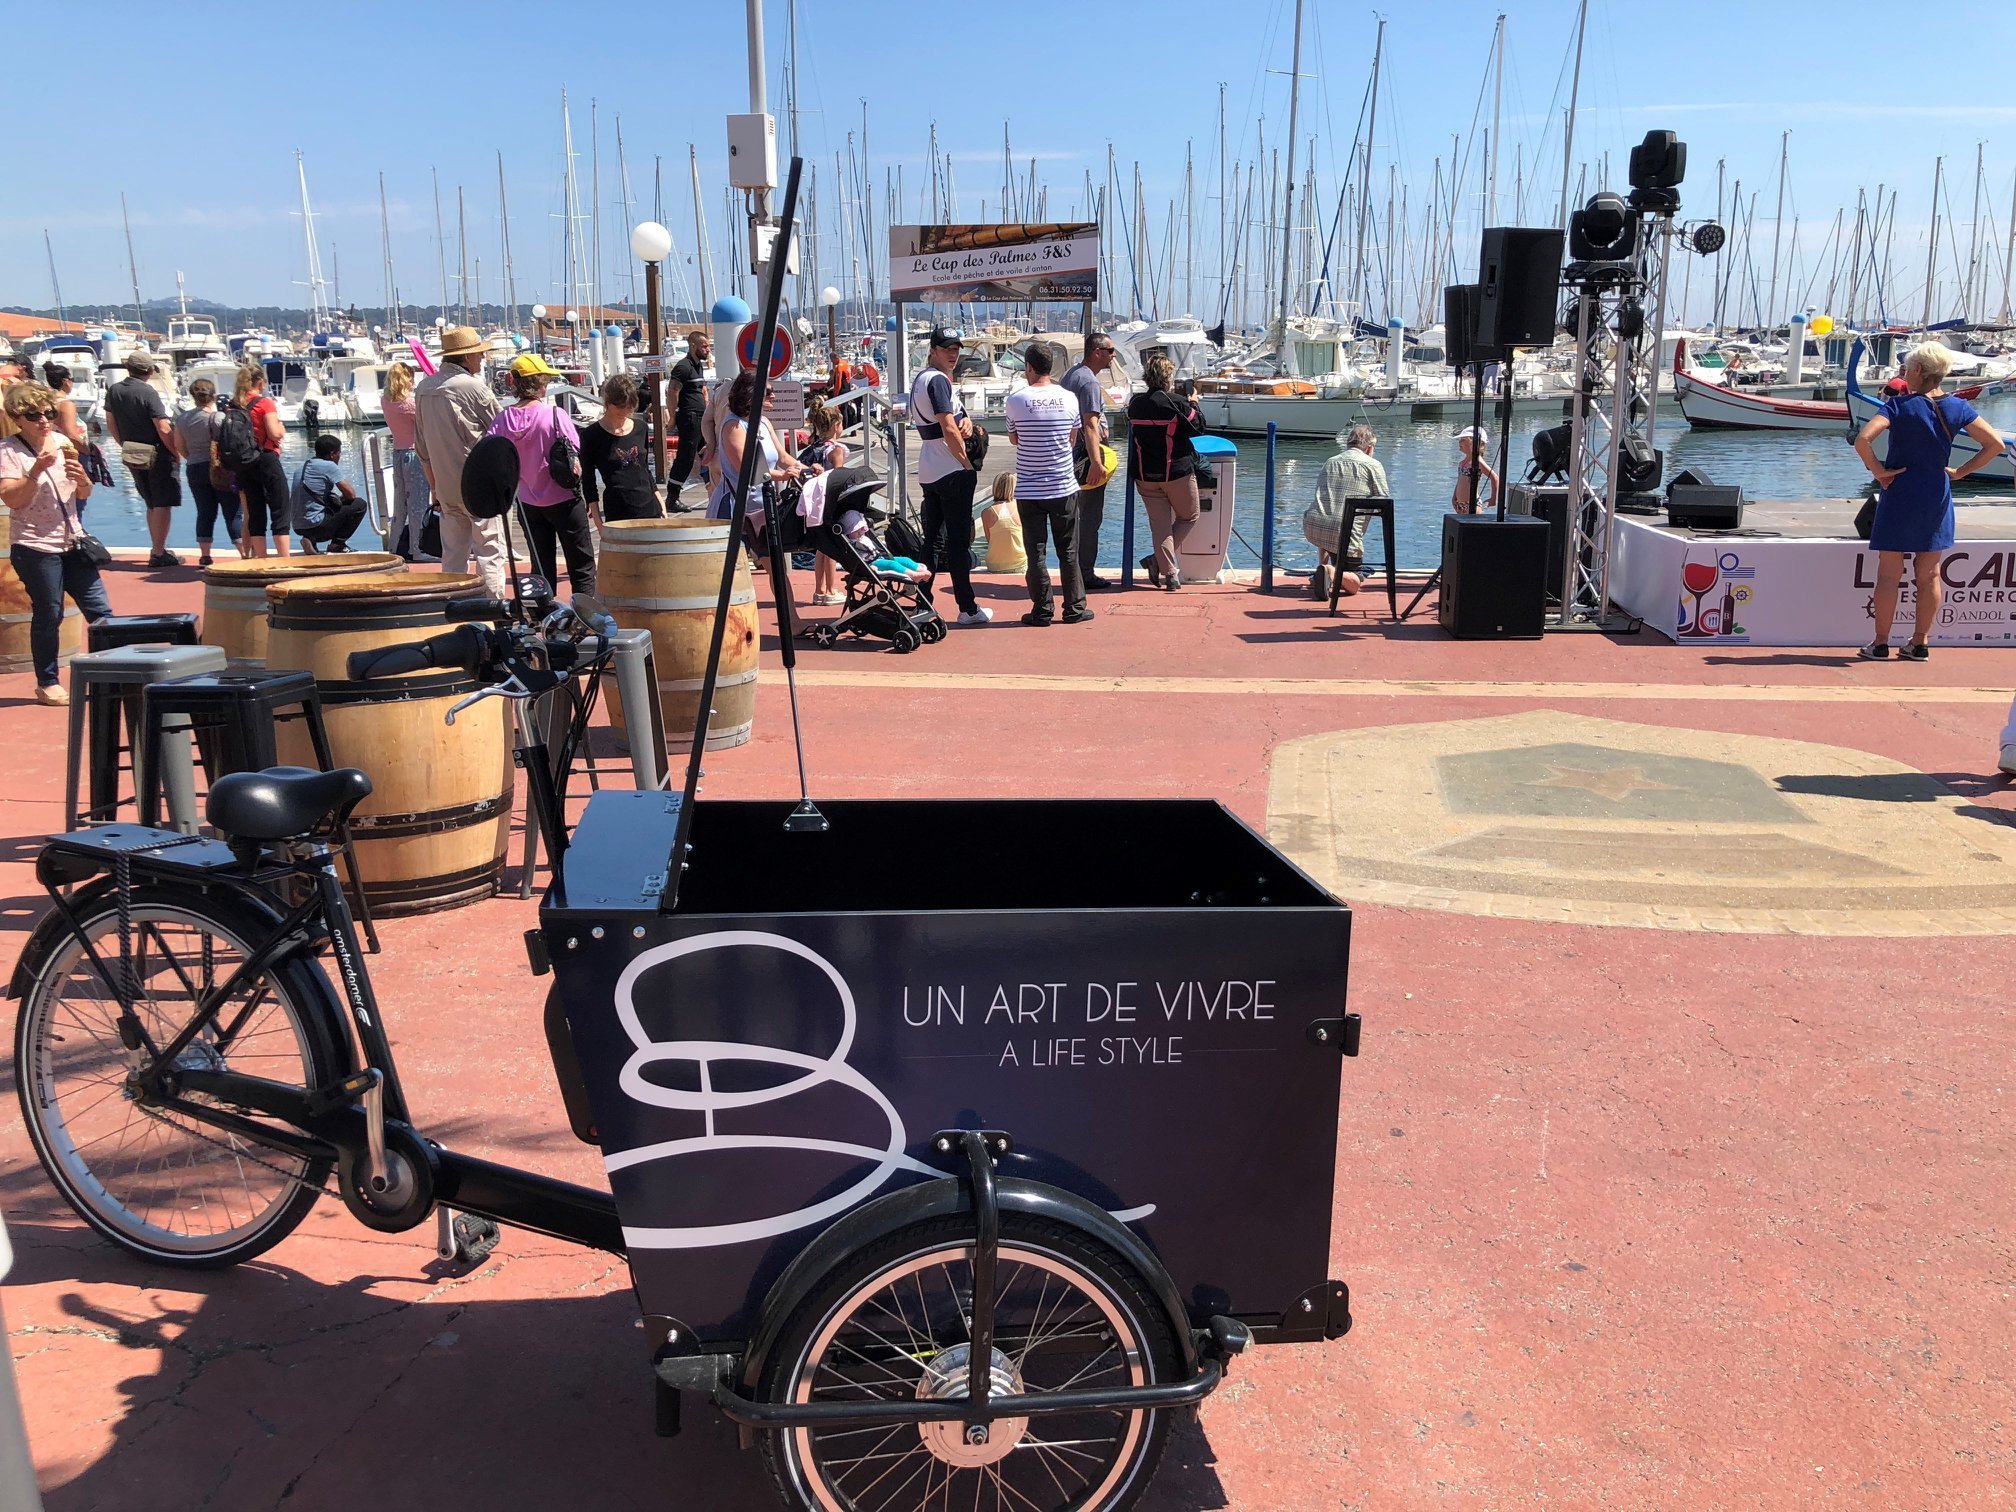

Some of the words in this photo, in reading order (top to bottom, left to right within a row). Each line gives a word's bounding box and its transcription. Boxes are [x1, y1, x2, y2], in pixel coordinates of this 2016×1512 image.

[912, 258, 928, 273] Le
[932, 257, 958, 275] Cap
[963, 252, 984, 267] des
[989, 249, 1037, 265] Palmes
[1042, 243, 1072, 260] F&S
[932, 274, 951, 283] Ecole
[952, 273, 962, 281] de
[986, 269, 994, 278] et
[995, 268, 1005, 276] de
[1006, 266, 1023, 275] voile
[1039, 285, 1093, 294] 06.31.50.92.50
[1024, 398, 1064, 407] L'ESCALE
[903, 985, 965, 1026] UN
[984, 983, 1067, 1024] ART
[1086, 982, 1138, 1022] DE
[1155, 980, 1276, 1022] VIVRE
[998, 1040, 1019, 1067] A
[1032, 1038, 1087, 1067] LIFE
[1098, 1036, 1183, 1065] STYLE
